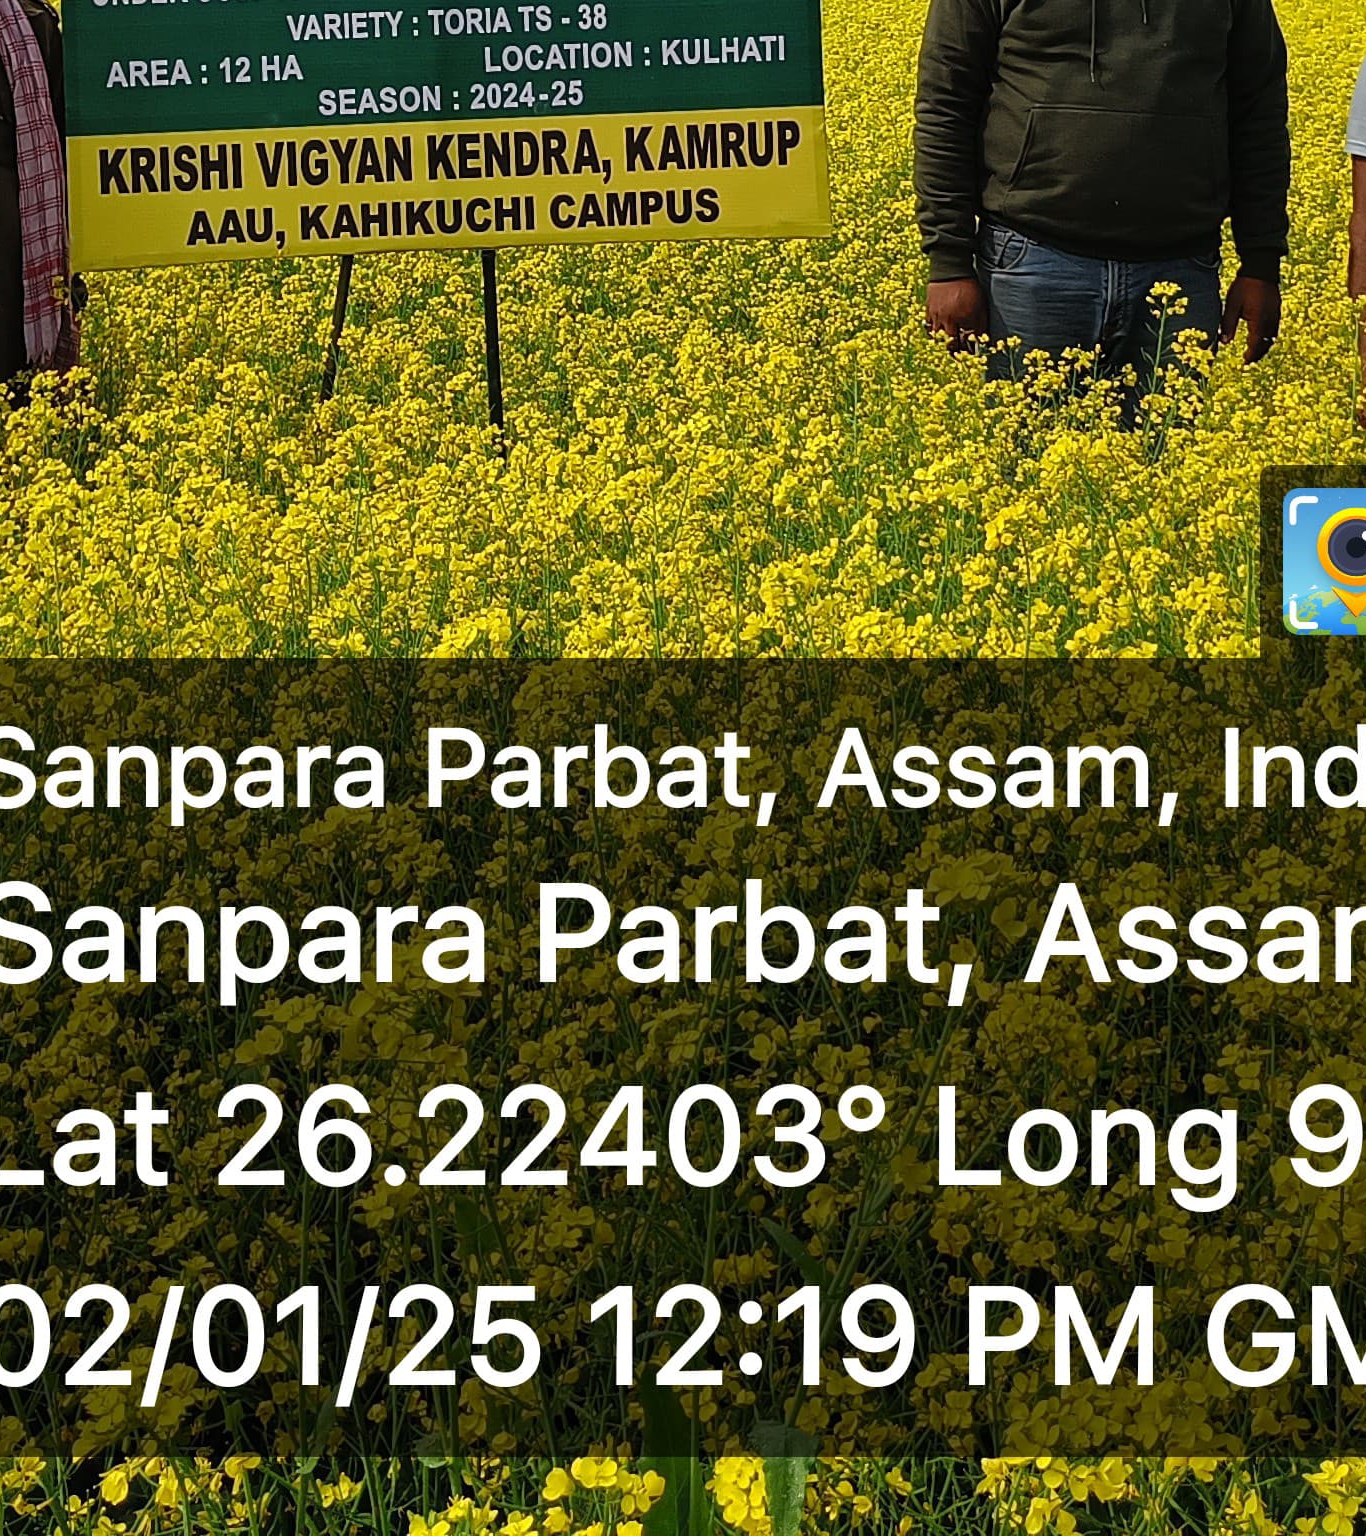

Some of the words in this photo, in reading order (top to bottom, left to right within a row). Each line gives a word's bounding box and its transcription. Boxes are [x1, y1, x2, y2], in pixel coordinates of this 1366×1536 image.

[286, 10, 404, 41] VARIETY
[427, 6, 513, 36] TORIA
[517, 5, 552, 32] TS
[578, 3, 607, 30] 38
[106, 58, 192, 88] AREA
[219, 56, 252, 83] 12
[261, 54, 304, 82] HA
[484, 41, 633, 73] LOCATION
[661, 35, 785, 66] KULHATI
[318, 85, 441, 116] SEASON
[470, 79, 584, 110] 2024-25
[98, 143, 243, 195] KRISHI
[255, 135, 413, 188] VIGYAN
[426, 128, 612, 185] KENDRA,
[624, 120, 801, 172] KAMRUP
[186, 207, 286, 250] AAU,
[300, 195, 535, 241] KAHIKUCHI
[549, 187, 720, 230] CAMPUS
